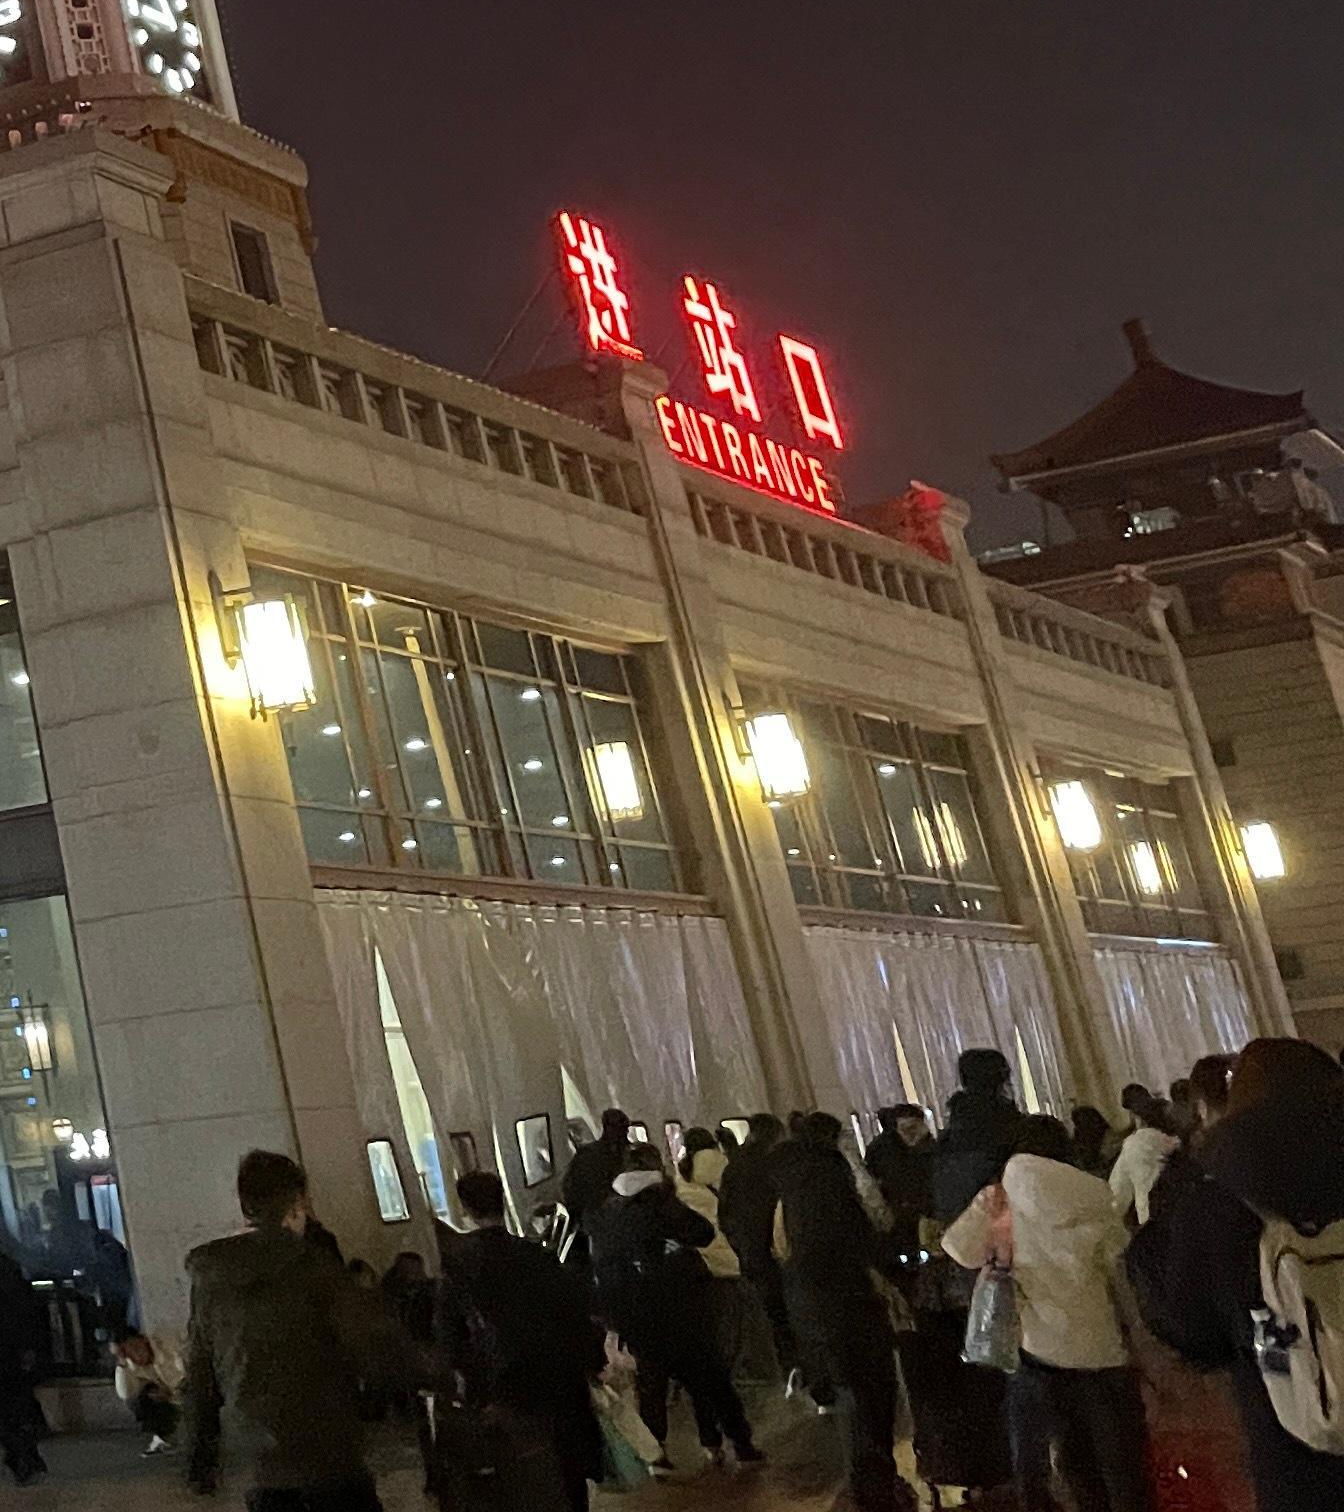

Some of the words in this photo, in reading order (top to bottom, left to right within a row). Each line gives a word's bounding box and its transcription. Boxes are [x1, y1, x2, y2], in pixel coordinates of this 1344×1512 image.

[559, 209, 845, 451] 进站口
[654, 394, 837, 514] ENTRANCE
